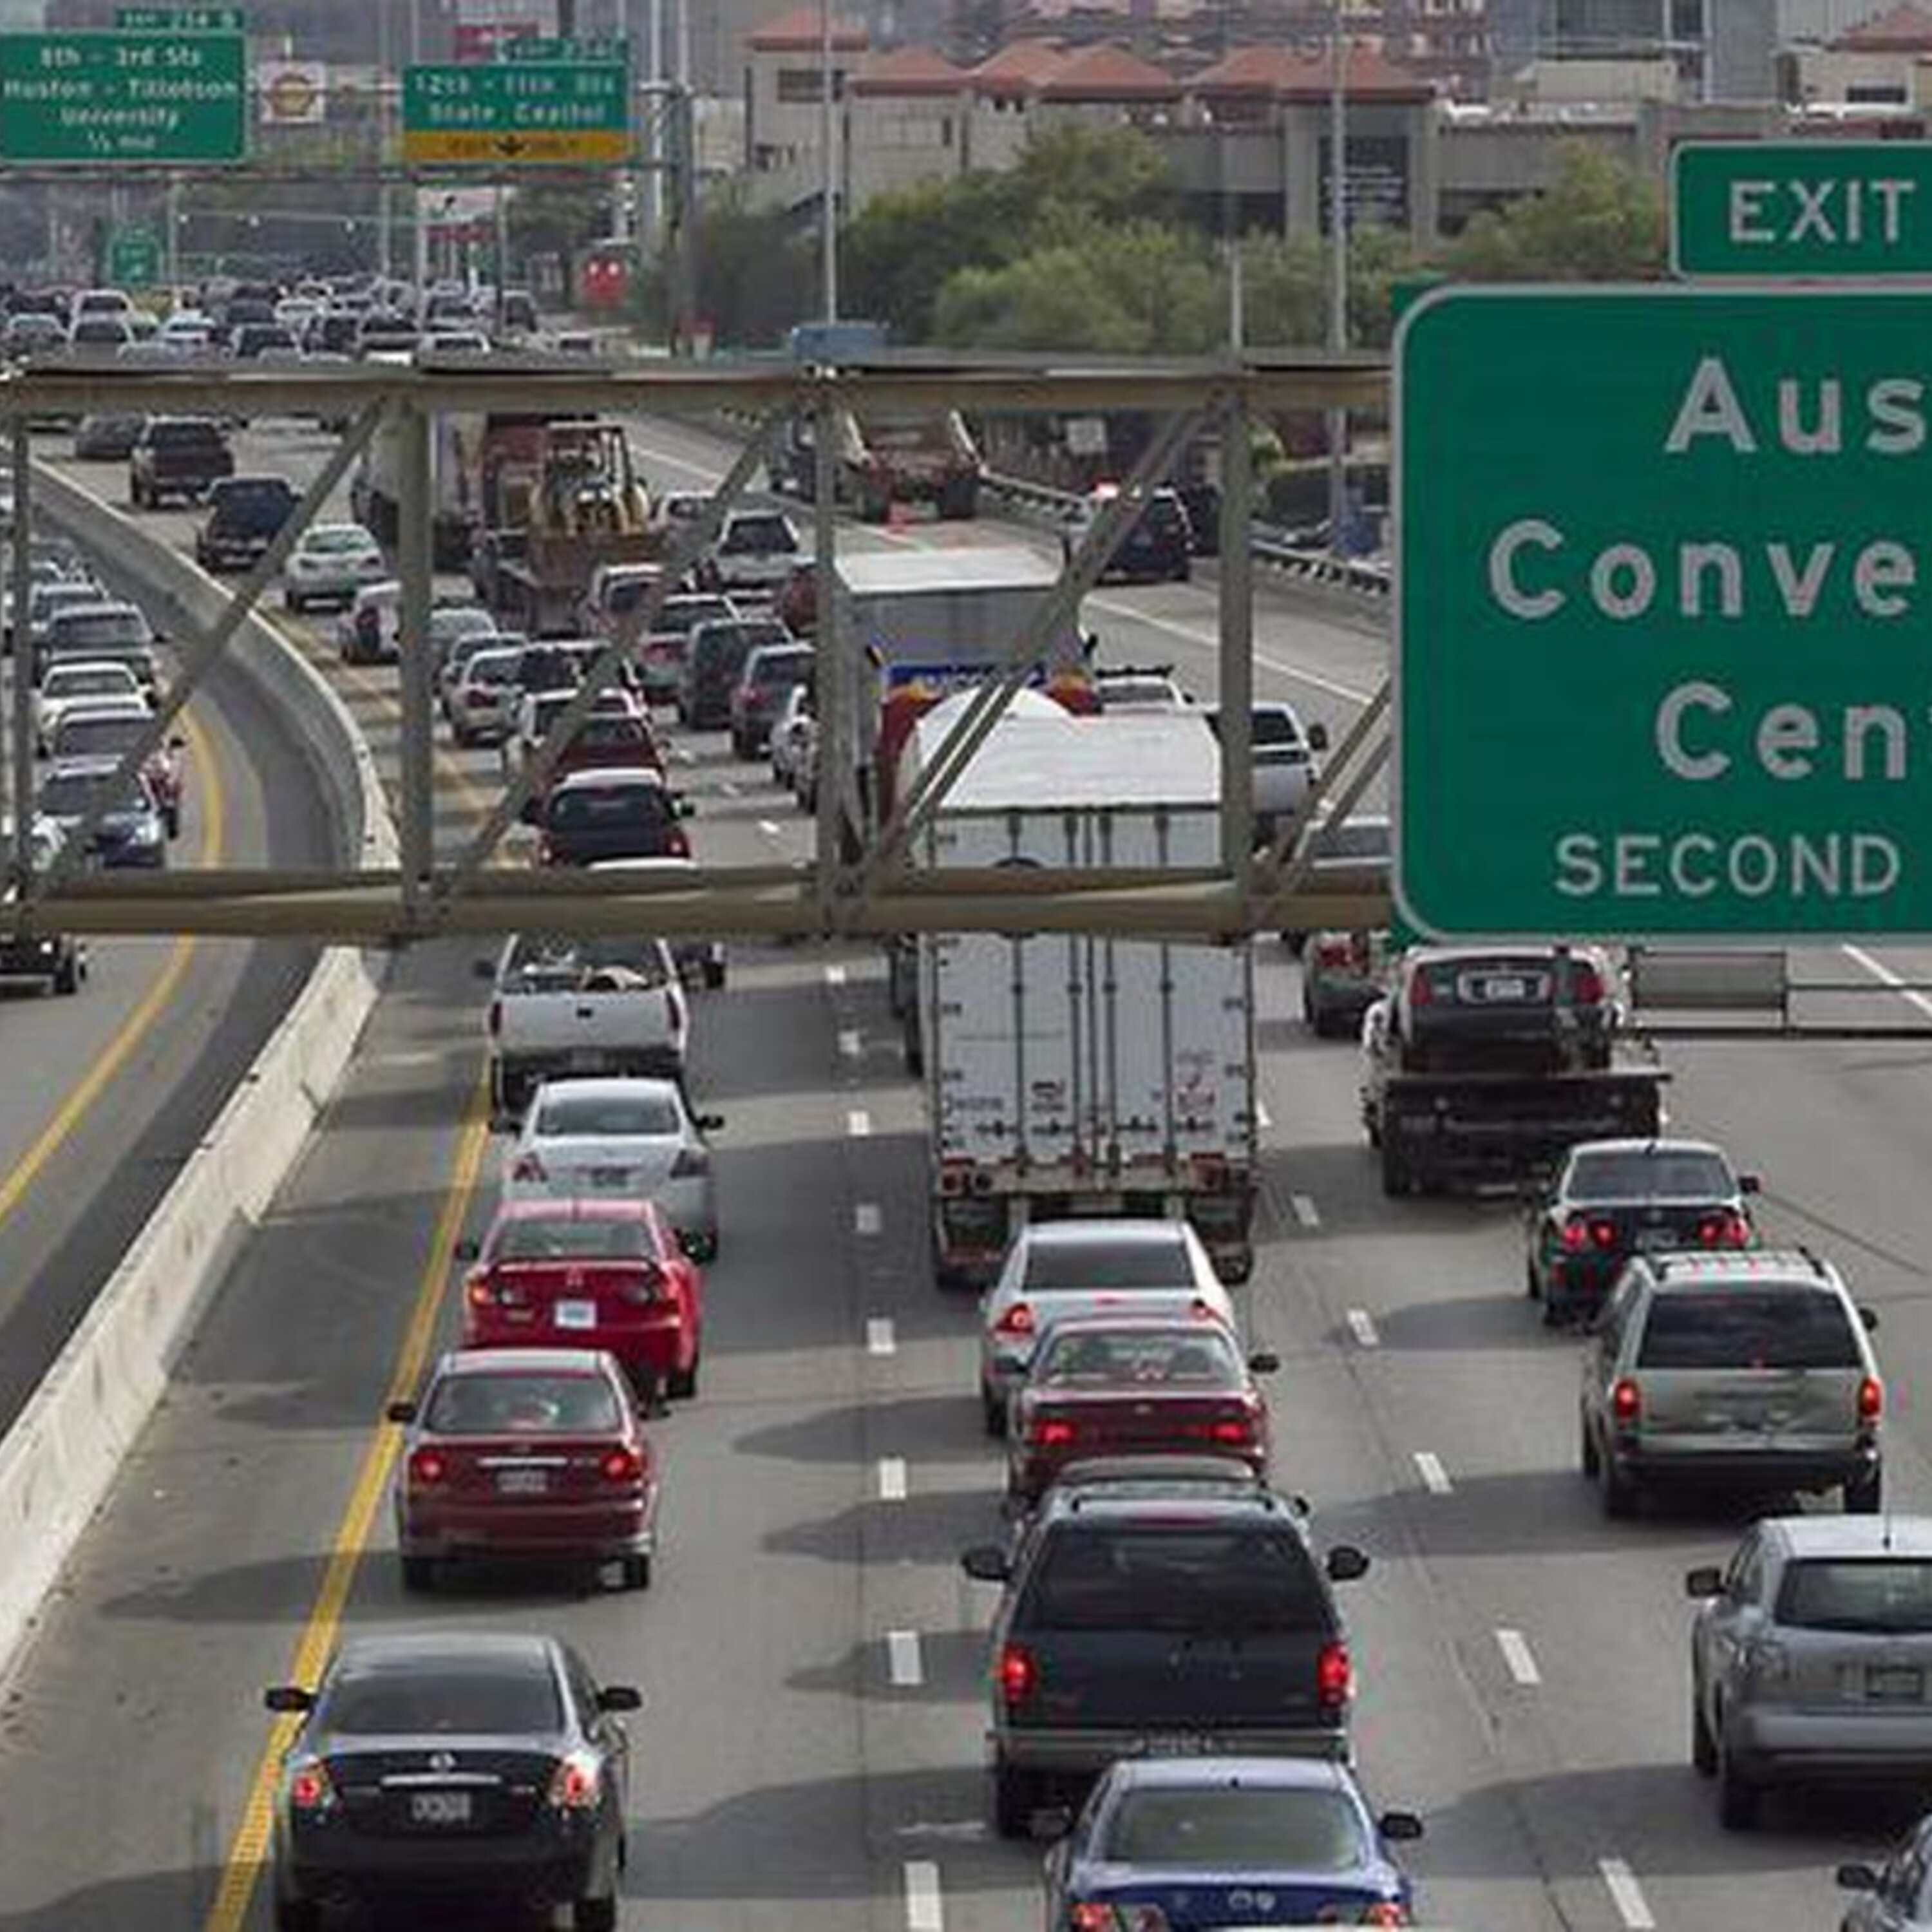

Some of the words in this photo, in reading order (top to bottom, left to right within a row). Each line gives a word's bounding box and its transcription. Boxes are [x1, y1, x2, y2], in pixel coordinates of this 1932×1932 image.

[1730, 180, 1915, 242] EXIT
[1665, 358, 1926, 453] Aus
[1489, 519, 1916, 618] Conve
[1656, 682, 1931, 779] Cen
[1555, 833, 1899, 895] SECOND
